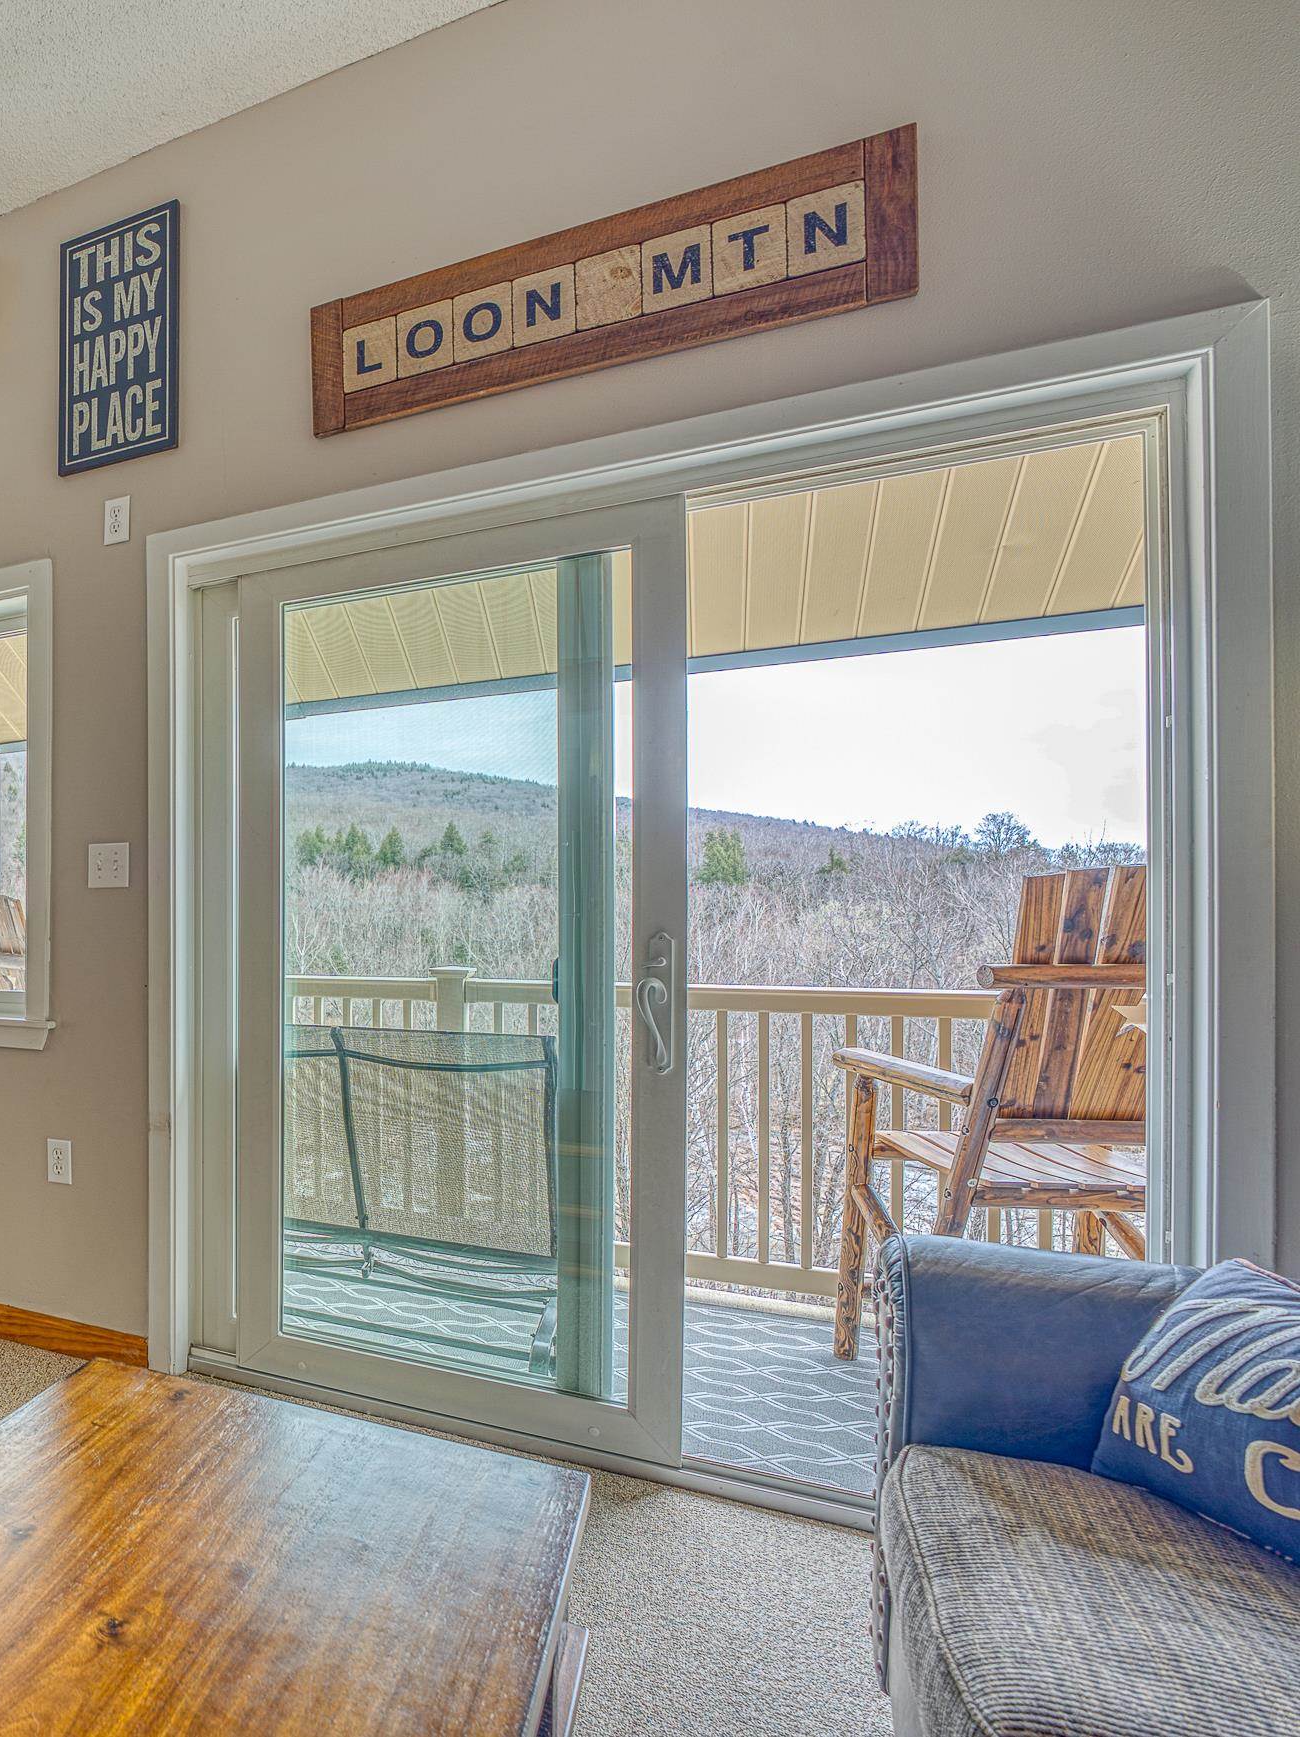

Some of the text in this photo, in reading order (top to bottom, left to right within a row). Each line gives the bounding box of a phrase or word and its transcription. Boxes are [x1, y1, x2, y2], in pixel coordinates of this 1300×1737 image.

[73, 222, 161, 289] THIS
[356, 203, 848, 375] LOON MTN
[73, 267, 162, 336] IS MY
[73, 315, 162, 396] HAPPY
[72, 378, 162, 456] PLACE
[1111, 1395, 1195, 1474] ARE
